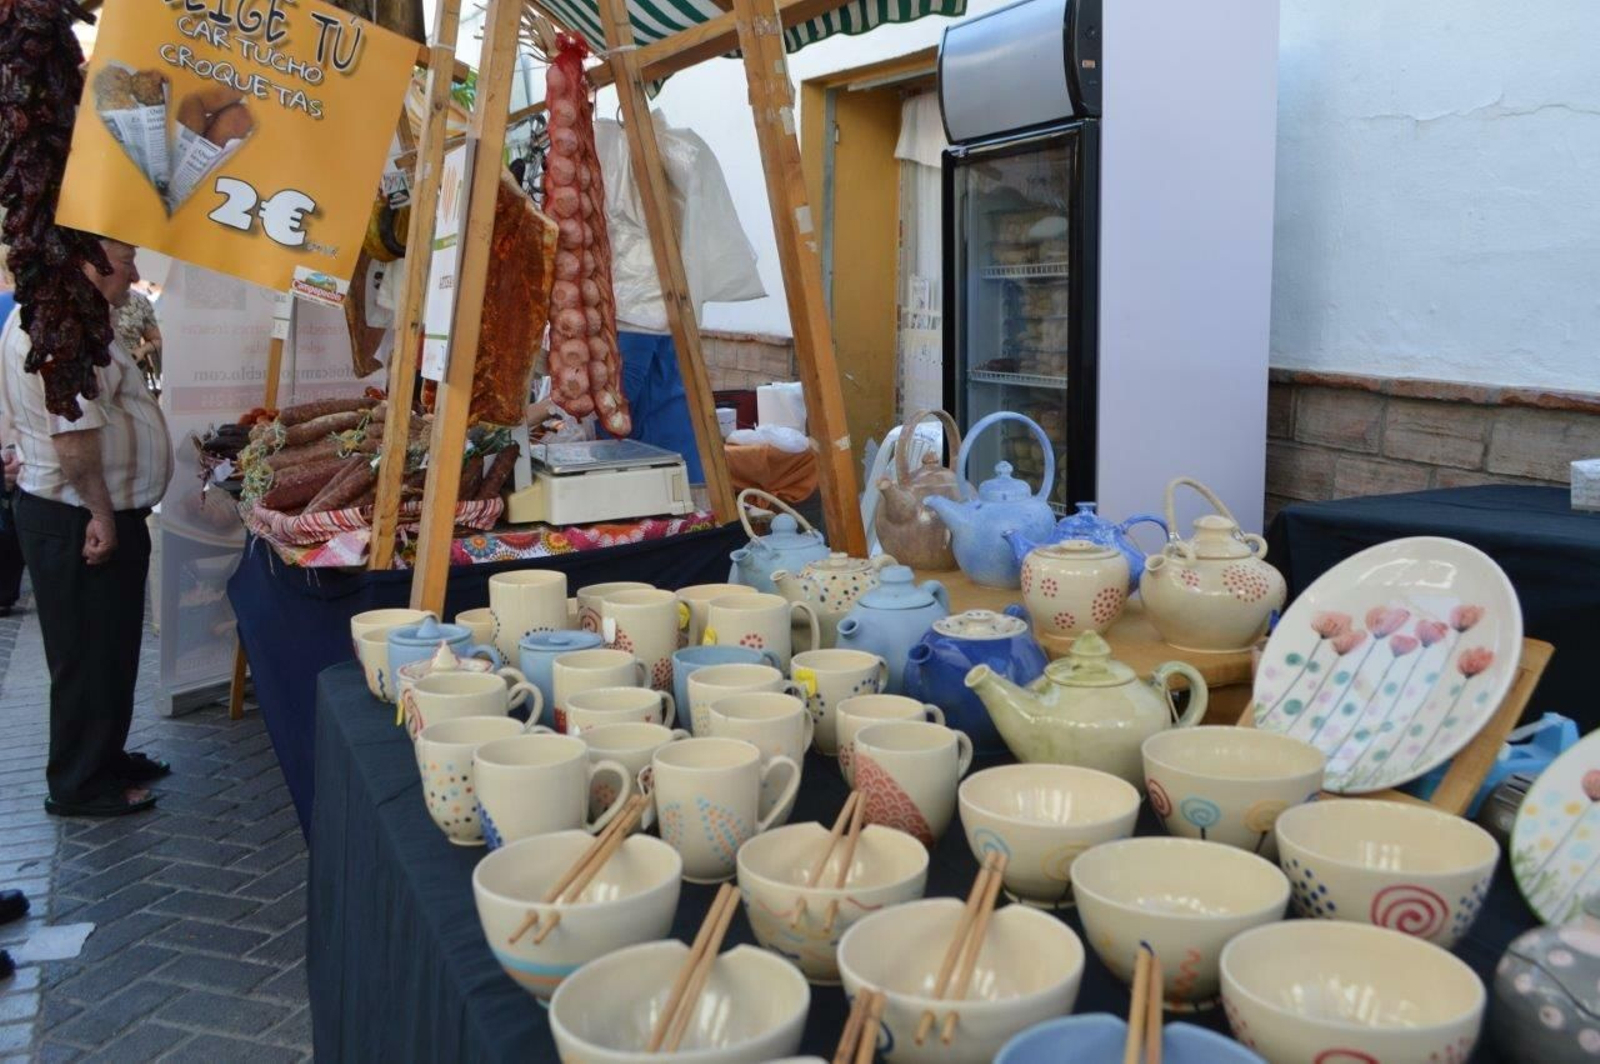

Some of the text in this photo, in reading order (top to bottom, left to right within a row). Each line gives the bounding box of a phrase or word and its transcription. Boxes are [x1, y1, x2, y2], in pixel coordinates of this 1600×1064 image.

[165, 0, 362, 72] IGE TÚ
[208, 176, 316, 246] 2€
